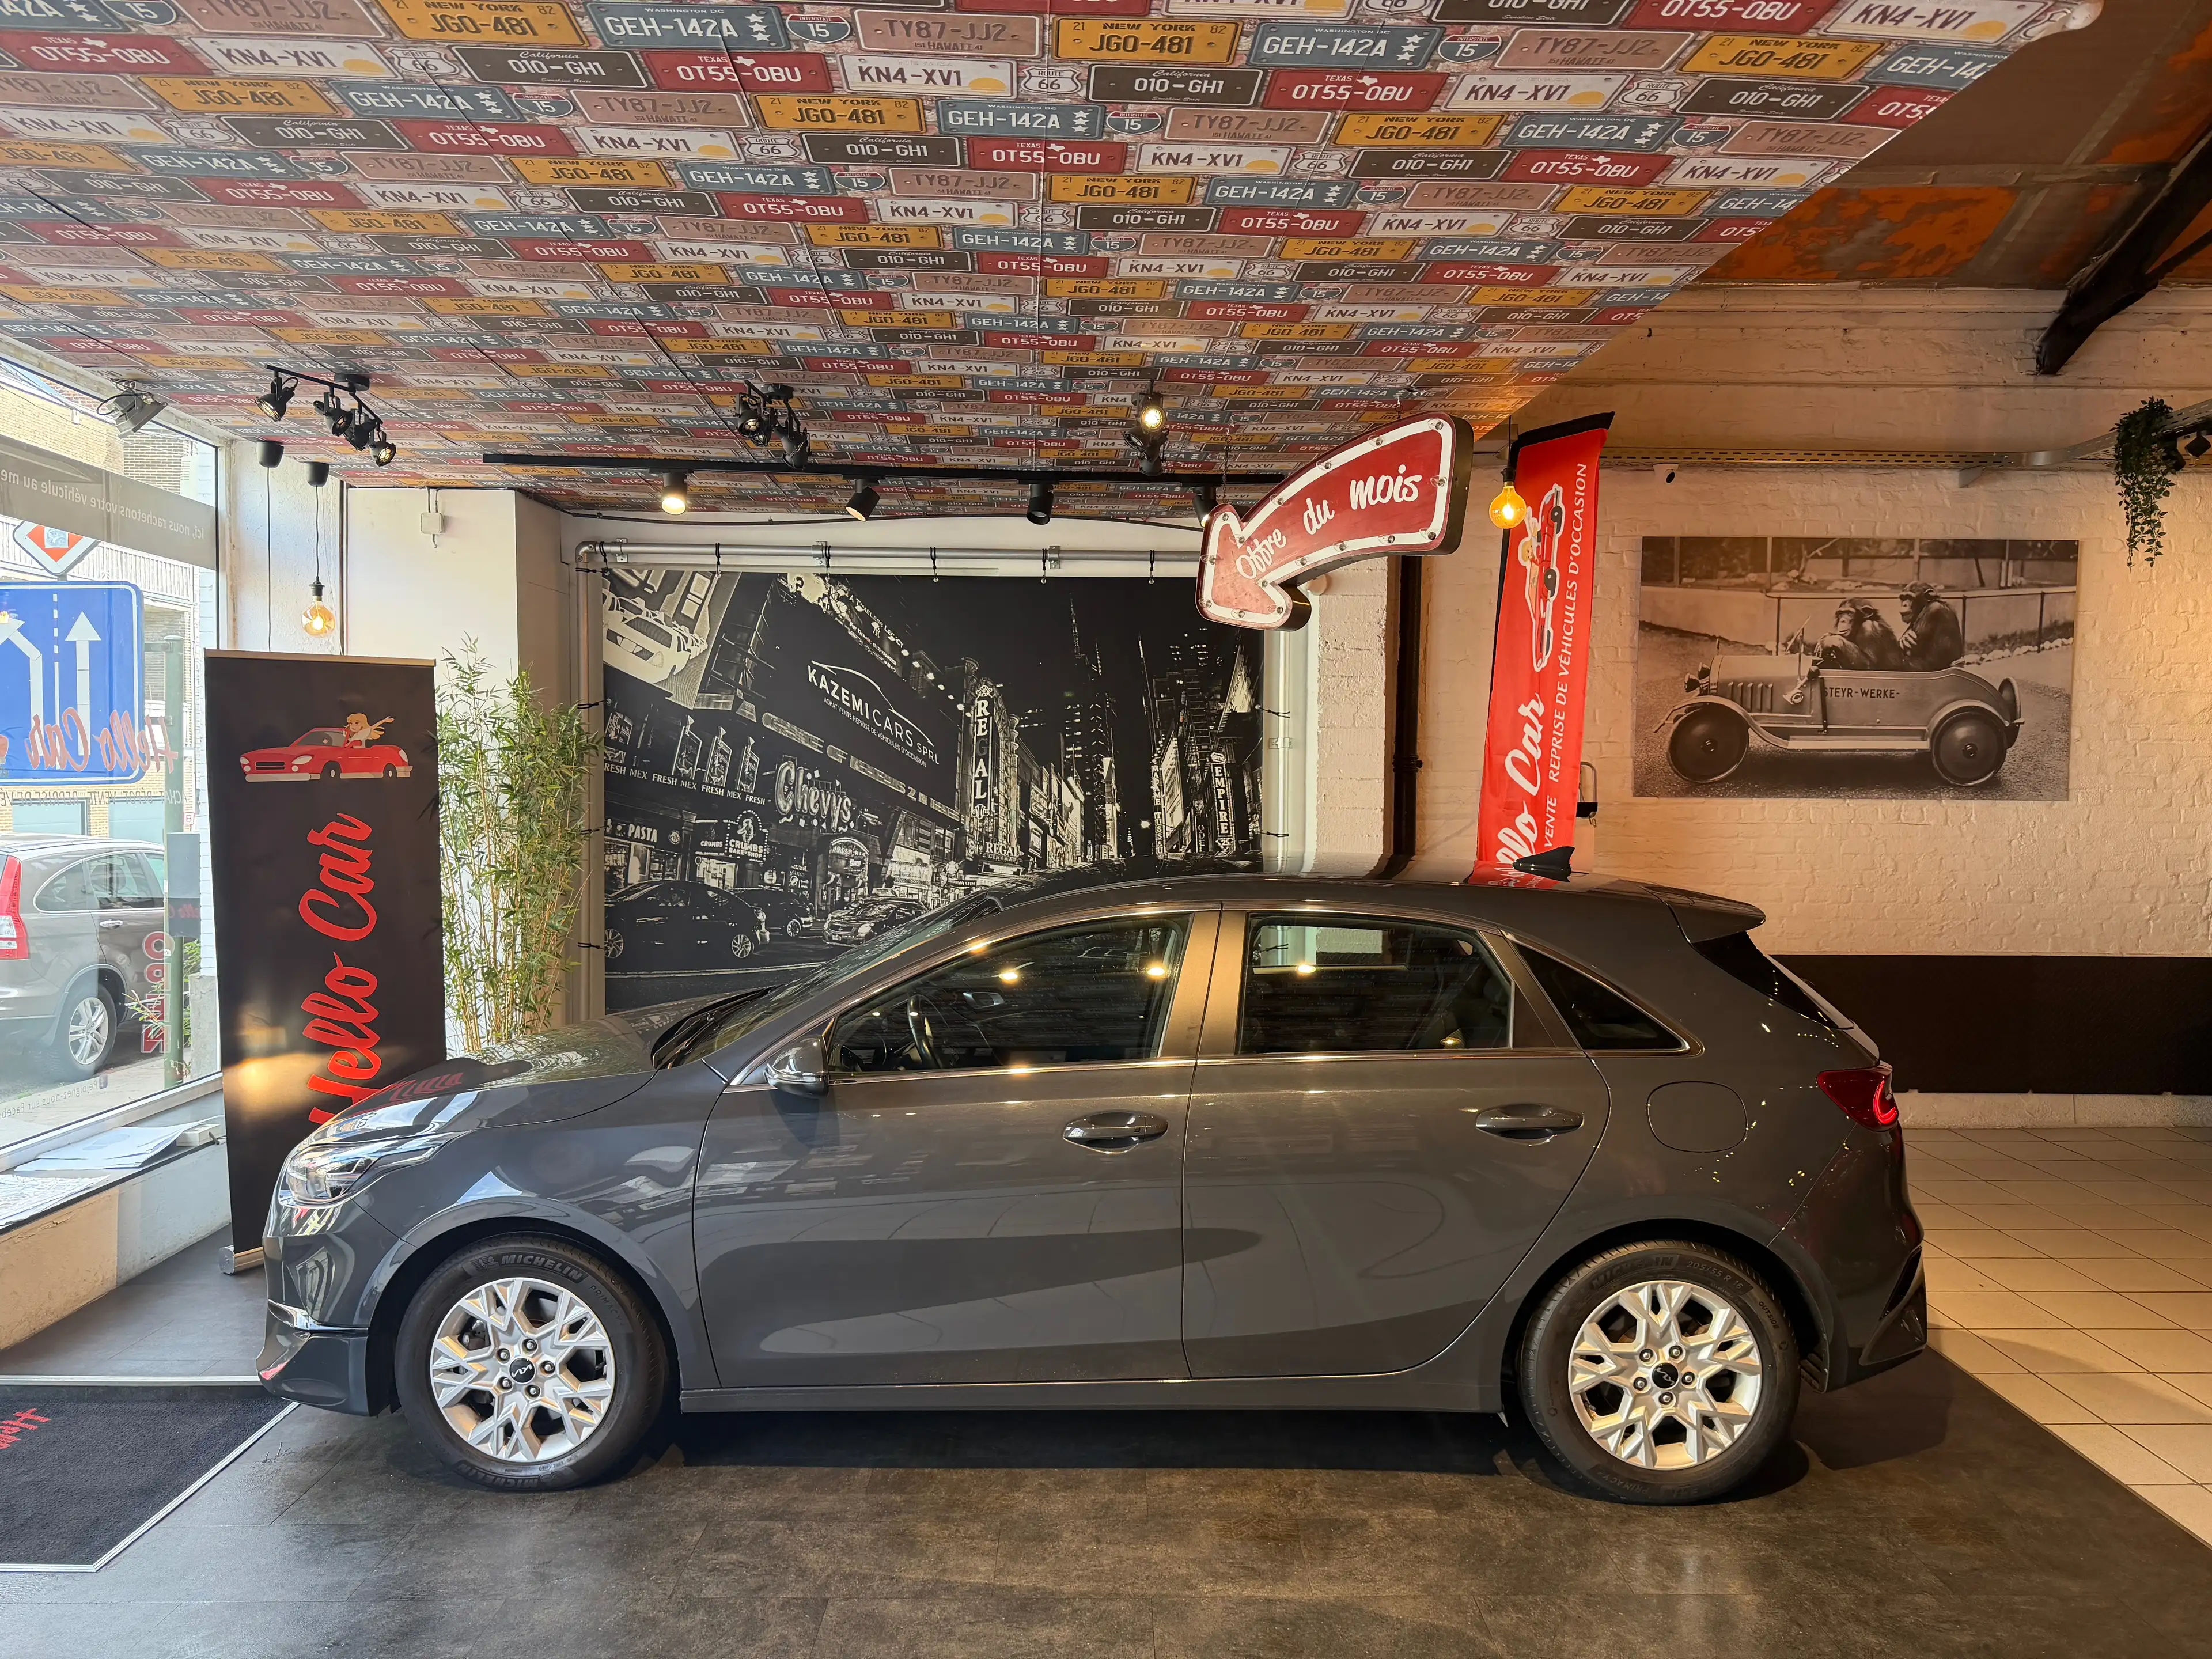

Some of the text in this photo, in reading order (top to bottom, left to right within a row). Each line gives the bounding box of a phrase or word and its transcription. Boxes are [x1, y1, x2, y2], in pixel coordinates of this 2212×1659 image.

[125, 3, 158, 18] 15
[426, 2, 554, 14] NEW YORK 82
[1851, 4, 1976, 30] KN4-XV1
[604, 17, 738, 38] GEH-142A
[806, 23, 830, 37] 15
[884, 18, 1007, 41] TY87-JJ2
[1073, 21, 1085, 30] 21
[1149, 23, 1196, 32] YORK
[1210, 25, 1226, 34] 82
[927, 41, 972, 51] HAWAII
[1263, 36, 1388, 57] GEH-142A
[1455, 43, 1478, 57] 15
[1533, 37, 1654, 56] TY87-JJ2
[1749, 39, 1869, 53] NEW YORK 82
[217, 48, 337, 67] KN4-XV1
[413, 60, 437, 71] 66
[858, 66, 961, 86] KN4-XV1
[1152, 70, 1211, 78] California
[1038, 79, 1061, 90] 66
[348, 92, 474, 111] GEH-142A
[1635, 91, 1660, 102] 66
[599, 97, 718, 115] TY87-JJ2
[282, 119, 341, 127] California
[948, 111, 1060, 128] GEH-142A
[1194, 115, 1300, 131] TY87-JJ2
[142, 154, 257, 171] GEH-142A
[691, 171, 796, 186] GEH-142A
[1682, 165, 1779, 180] KN4-XV1
[1369, 192, 1386, 201] 15
[292, 260, 389, 271] GEH-142A
[912, 298, 982, 308] KN4-XV1
[1325, 310, 1395, 318] KN4-XV1
[971, 318, 1049, 329] GEH-142A
[1160, 357, 1230, 366] GEH-142A
[1236, 464, 1422, 579] Offre du mois
[1544, 463, 1587, 848] VENTE REPRISE DE VÉHICULES D'OCCASION
[824, 696, 927, 768] ACHAT VENTE REPRISE DE VÉHICULES D'OCCASION
[974, 700, 990, 799] REGAL
[1505, 692, 1544, 796] Car
[917, 743, 940, 765] SPRL
[604, 763, 766, 805] RESH MEX FRESH MEX FRESH MEX FRESH
[1151, 765, 1161, 806] MADAME
[775, 760, 851, 832] Chevys
[1214, 766, 1229, 834] EMPIRE
[628, 824, 657, 843] PASTA
[729, 839, 763, 853] CRUMBS
[298, 813, 382, 1125] Hello Car
[501, 1254, 583, 1281] MICHELIN
[1687, 1260, 1744, 1290] 205/55 R 16
[1759, 1301, 1780, 1329] OUTSIDE
